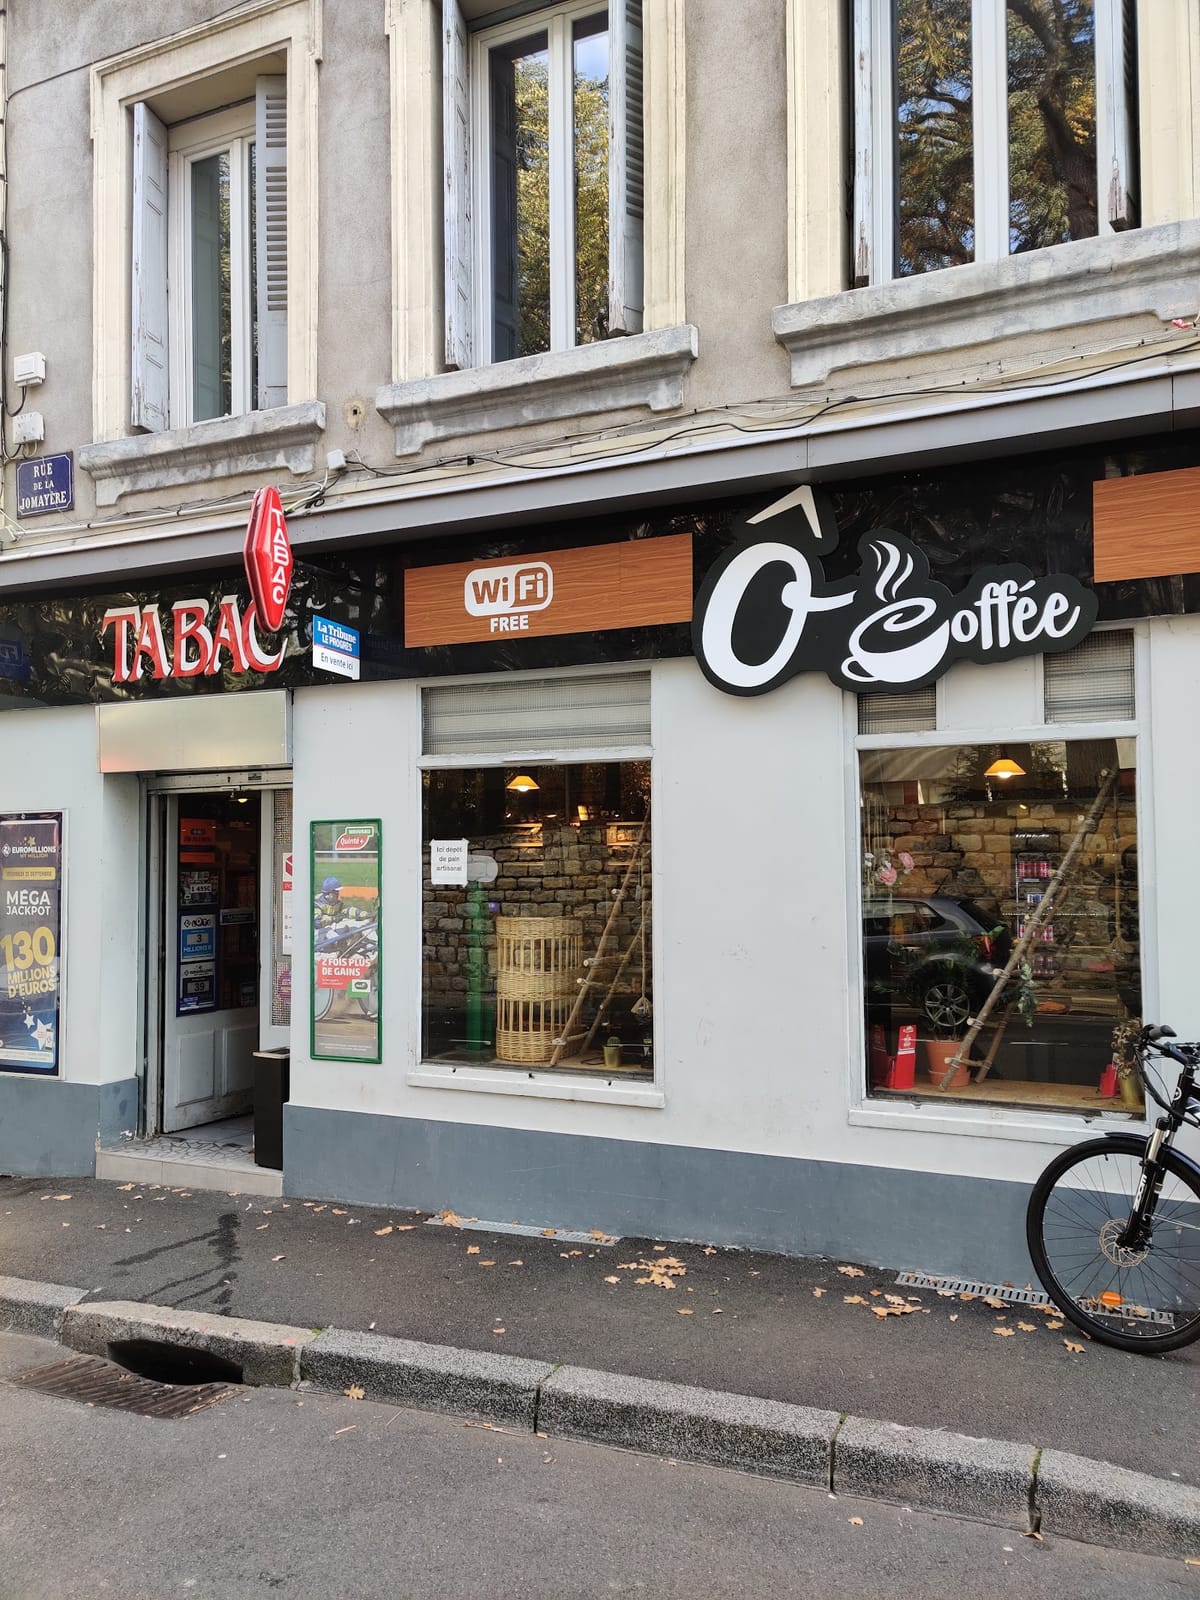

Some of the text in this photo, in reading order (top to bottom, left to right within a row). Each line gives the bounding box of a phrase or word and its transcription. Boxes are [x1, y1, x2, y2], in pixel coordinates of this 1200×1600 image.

[33, 463, 53, 478] RUE
[33, 480, 54, 491] DE LA
[271, 508, 290, 605] TABAC
[702, 485, 858, 688] Ô
[317, 620, 357, 644] La Tribune
[490, 614, 529, 633] FREE
[102, 594, 288, 683] TABAC
[321, 633, 329, 645] LE
[320, 652, 354, 671] En vente ici
[12, 845, 57, 854] EUROMILLIONS
[447, 855, 460, 864] pain
[6, 906, 51, 916] JACKPOT
[0, 926, 56, 972] 130
[321, 967, 361, 976] DE GAINS
[328, 958, 347, 967] FOIS
[348, 957, 371, 967] PLUS
[8, 966, 56, 985] MILLIONS
[8, 978, 57, 999] D'EUROS
